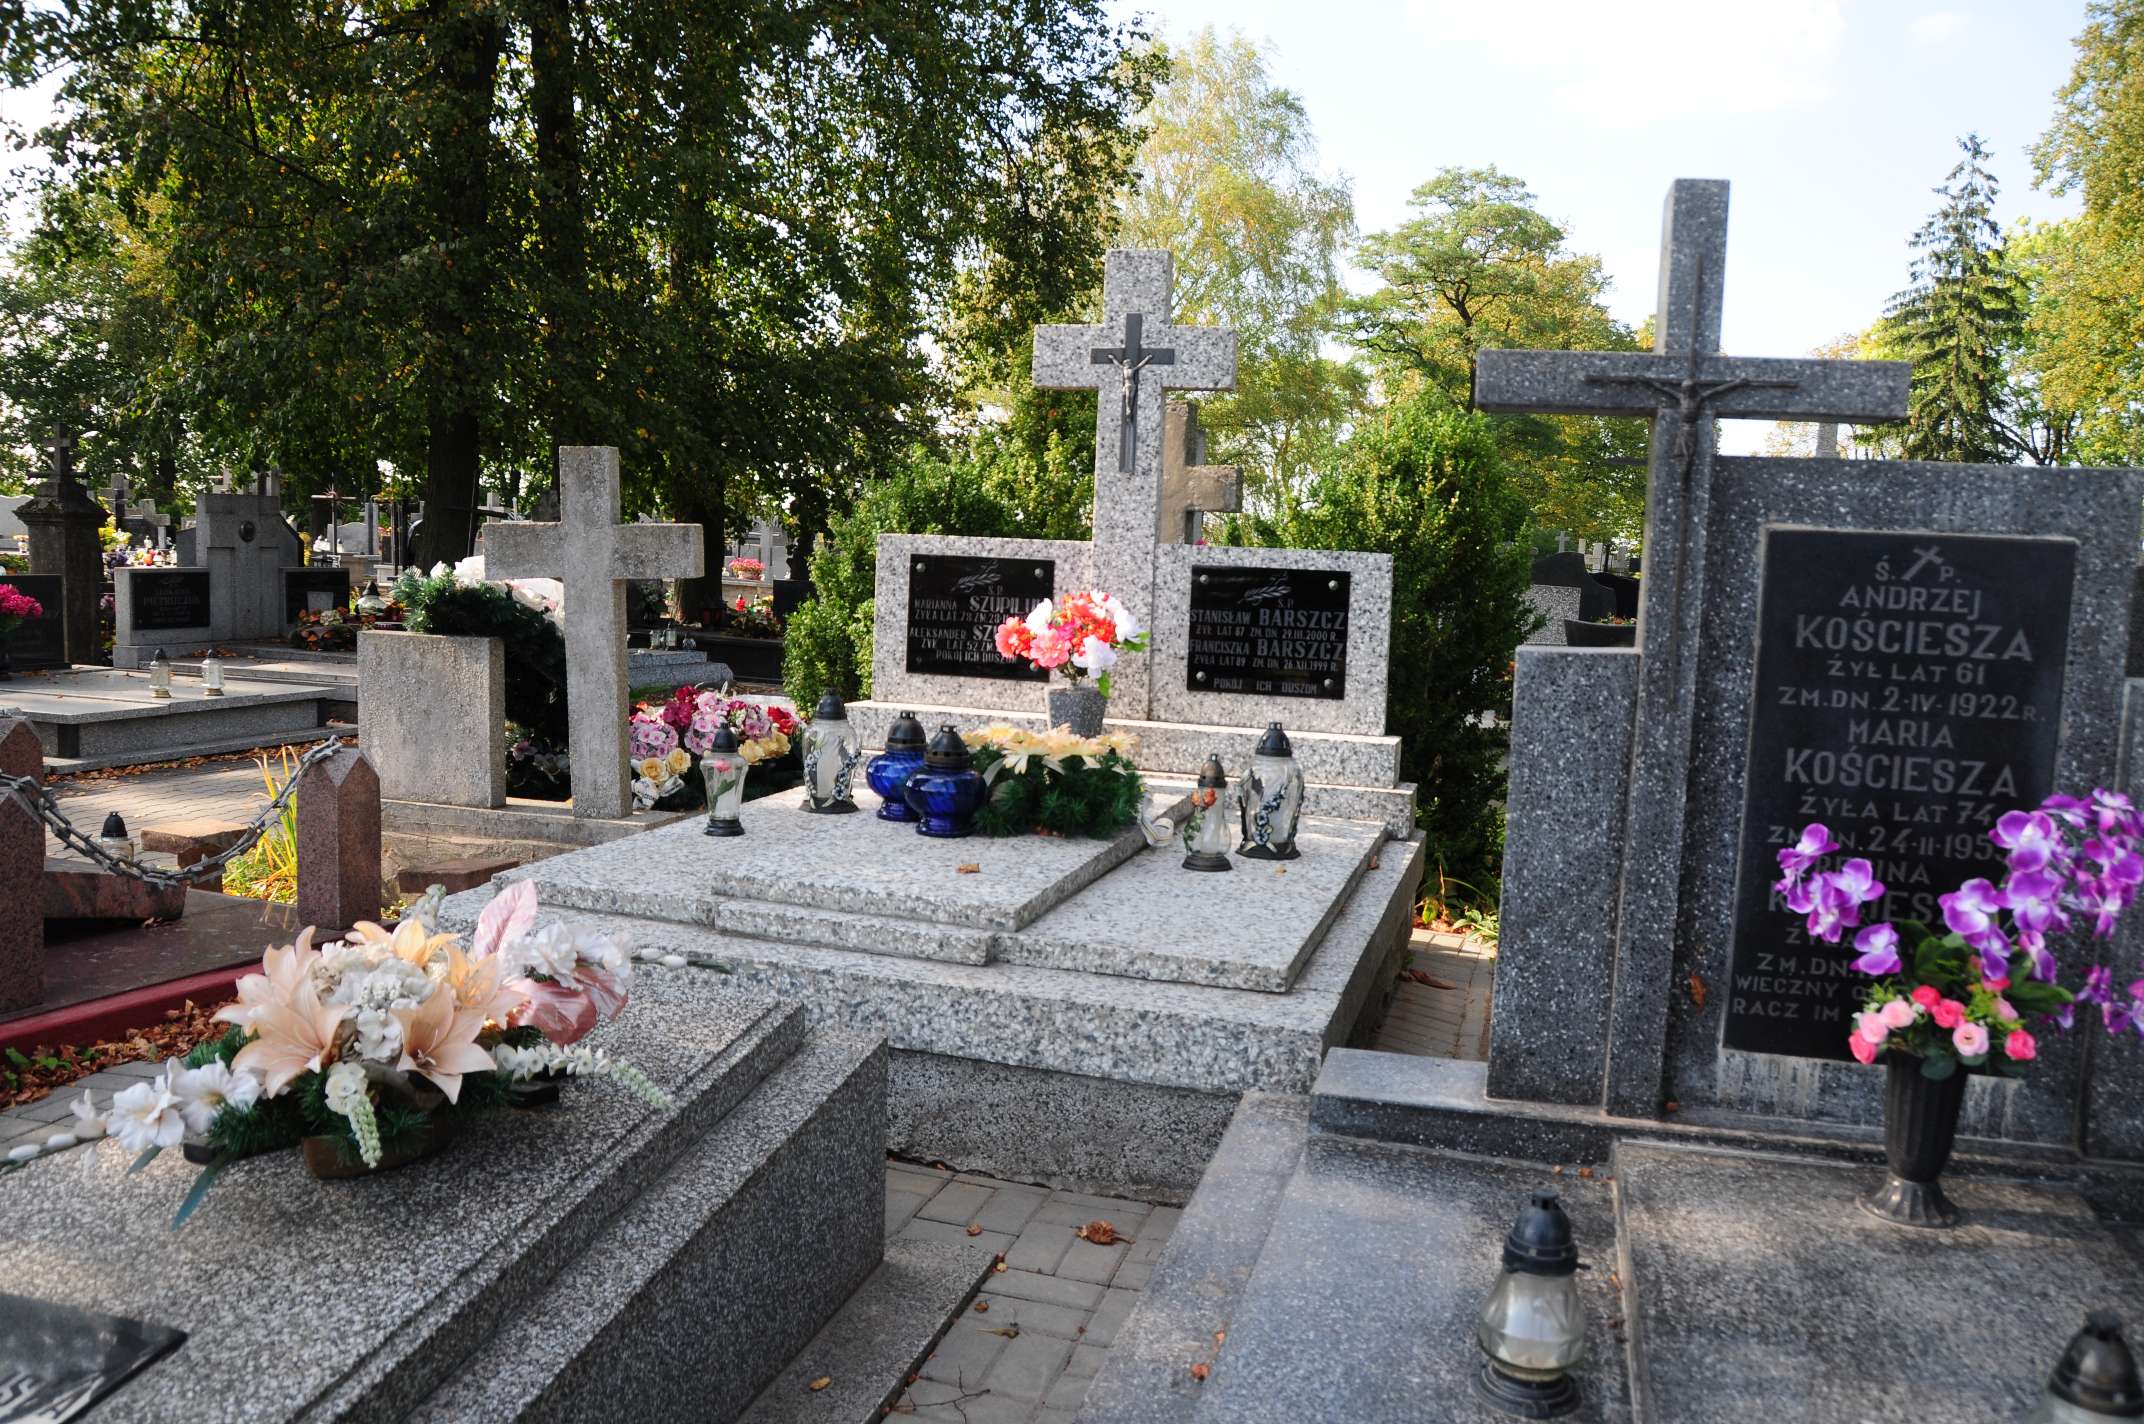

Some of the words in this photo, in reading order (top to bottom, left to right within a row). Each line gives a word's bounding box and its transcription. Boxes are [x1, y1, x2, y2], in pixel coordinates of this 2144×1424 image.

[1838, 584, 1982, 621] ANDRZEJ
[1259, 608, 1345, 630] BARSZCZ
[1795, 611, 2033, 663] KOŚCIESZA
[1257, 638, 1344, 661] BARSZCZ
[1891, 663, 1948, 683] LAT
[1955, 662, 1985, 685] 61
[1256, 680, 1272, 692] ICH
[1847, 719, 1955, 749] MARIA
[1784, 744, 2018, 798] KOŚCIESZA
[1893, 801, 1949, 823] LAT
[1735, 974, 1840, 998] WIECZNY
[1732, 998, 1800, 1018] RACZ
[1814, 1005, 1841, 1023] IM
